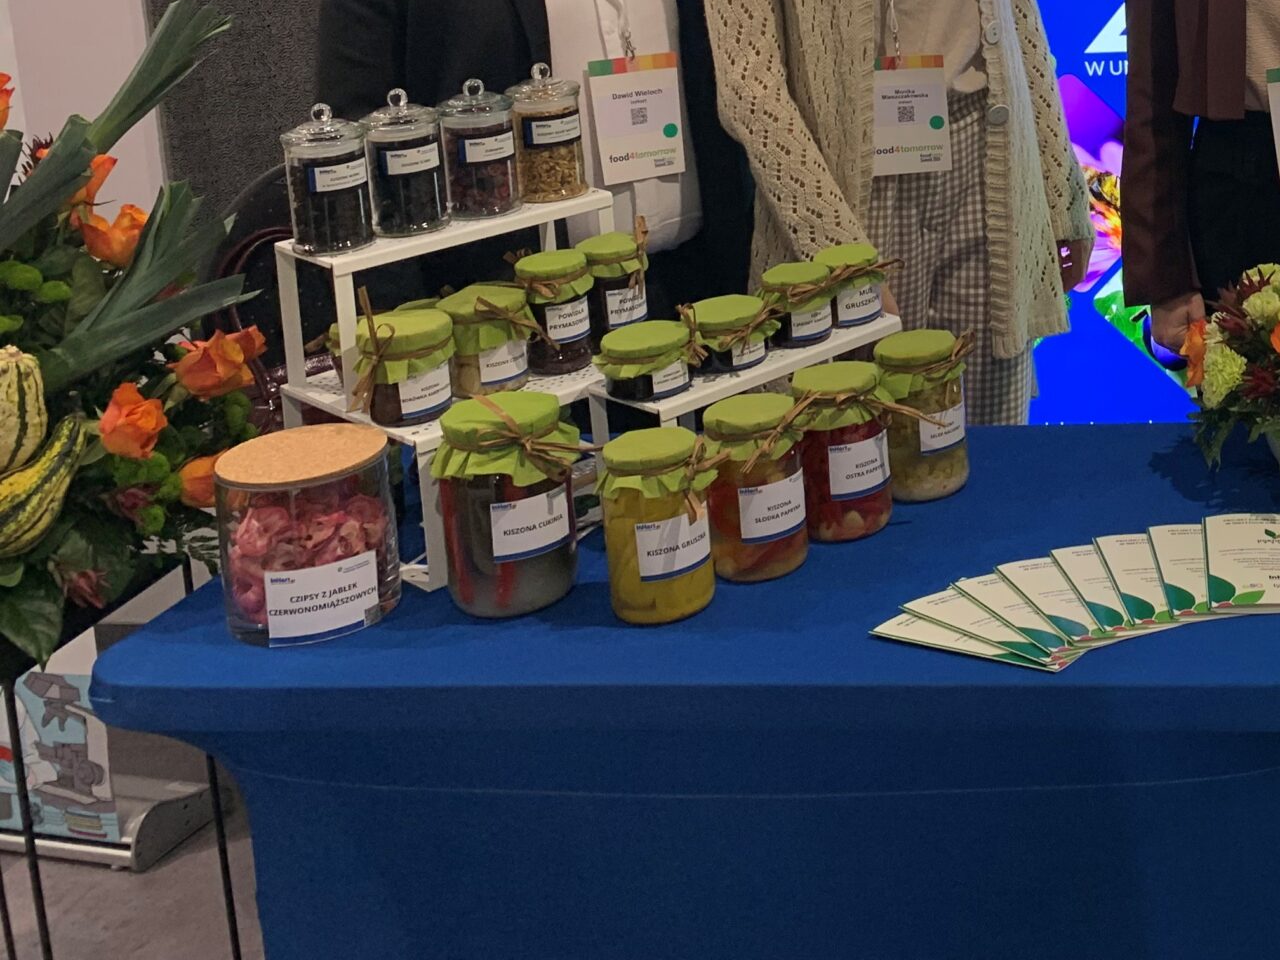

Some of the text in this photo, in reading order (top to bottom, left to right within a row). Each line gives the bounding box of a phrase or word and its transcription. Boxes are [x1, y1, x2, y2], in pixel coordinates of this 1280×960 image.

[1084, 60, 1105, 76] W
[609, 147, 677, 164] food4tomorrow
[874, 144, 944, 155] ood4tomorrow
[503, 524, 537, 537] KISZONA
[646, 545, 680, 557] KISZONA
[290, 582, 358, 604] CZIPSY Z JABŁEK
